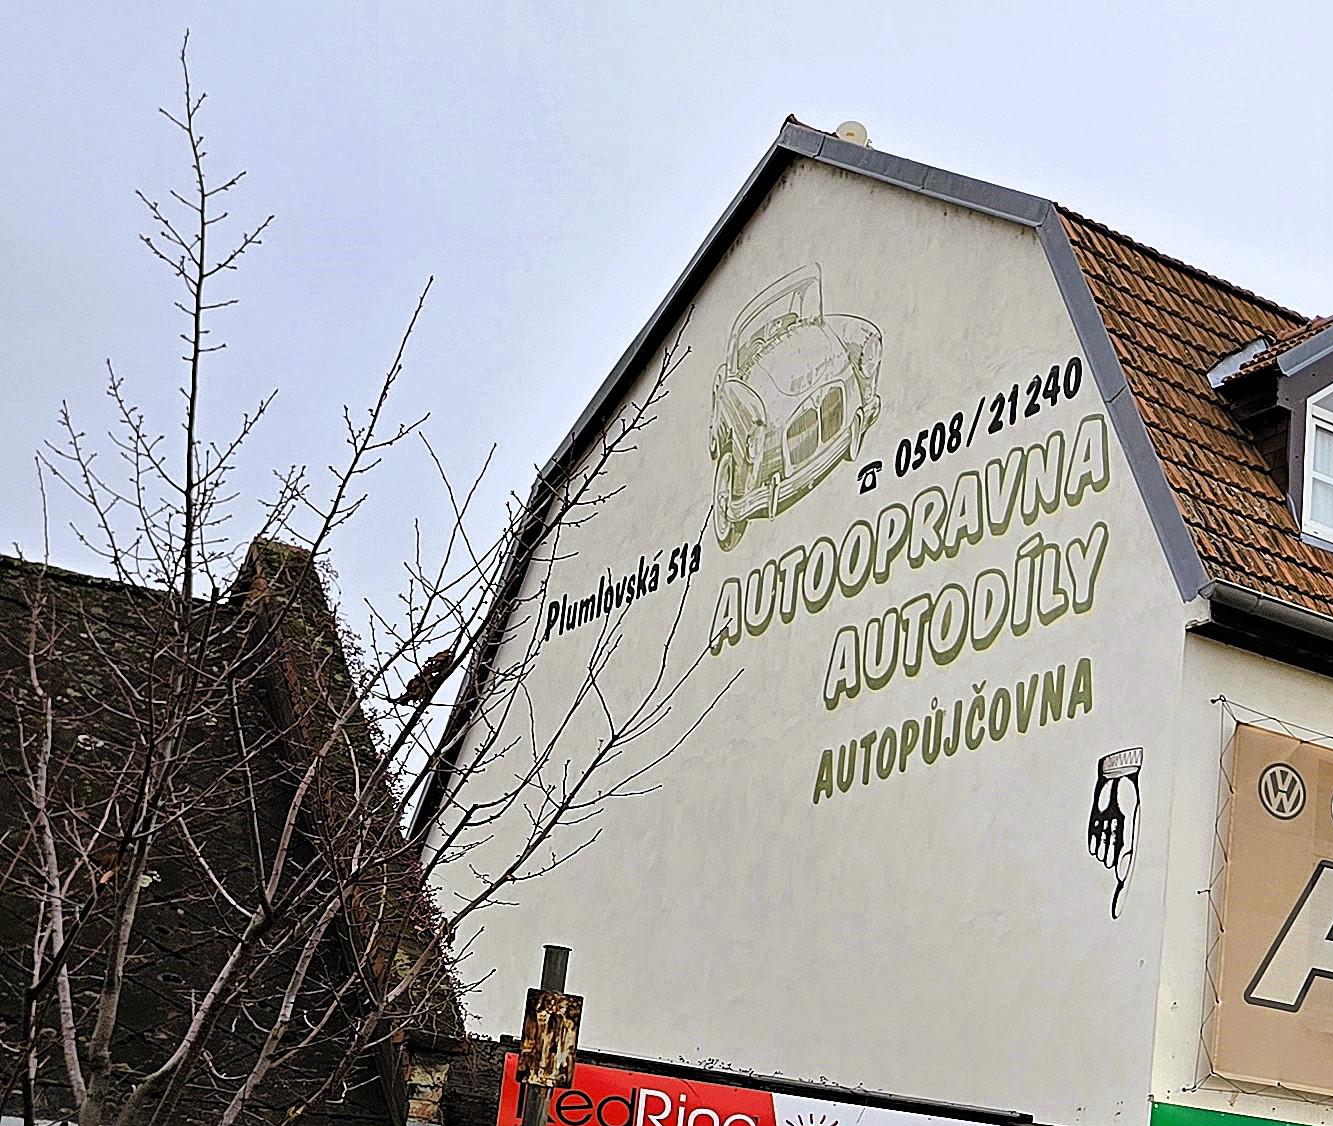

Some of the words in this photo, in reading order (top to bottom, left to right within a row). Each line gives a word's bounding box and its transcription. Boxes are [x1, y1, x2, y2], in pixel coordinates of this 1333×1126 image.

[545, 549, 664, 642] Plumlovská
[667, 543, 702, 584] 51a
[709, 413, 1111, 656] AUTOOPRAVNA
[823, 520, 1109, 711] AUTODÍLY
[812, 656, 1093, 805] AUTOPŮJČOVNA
